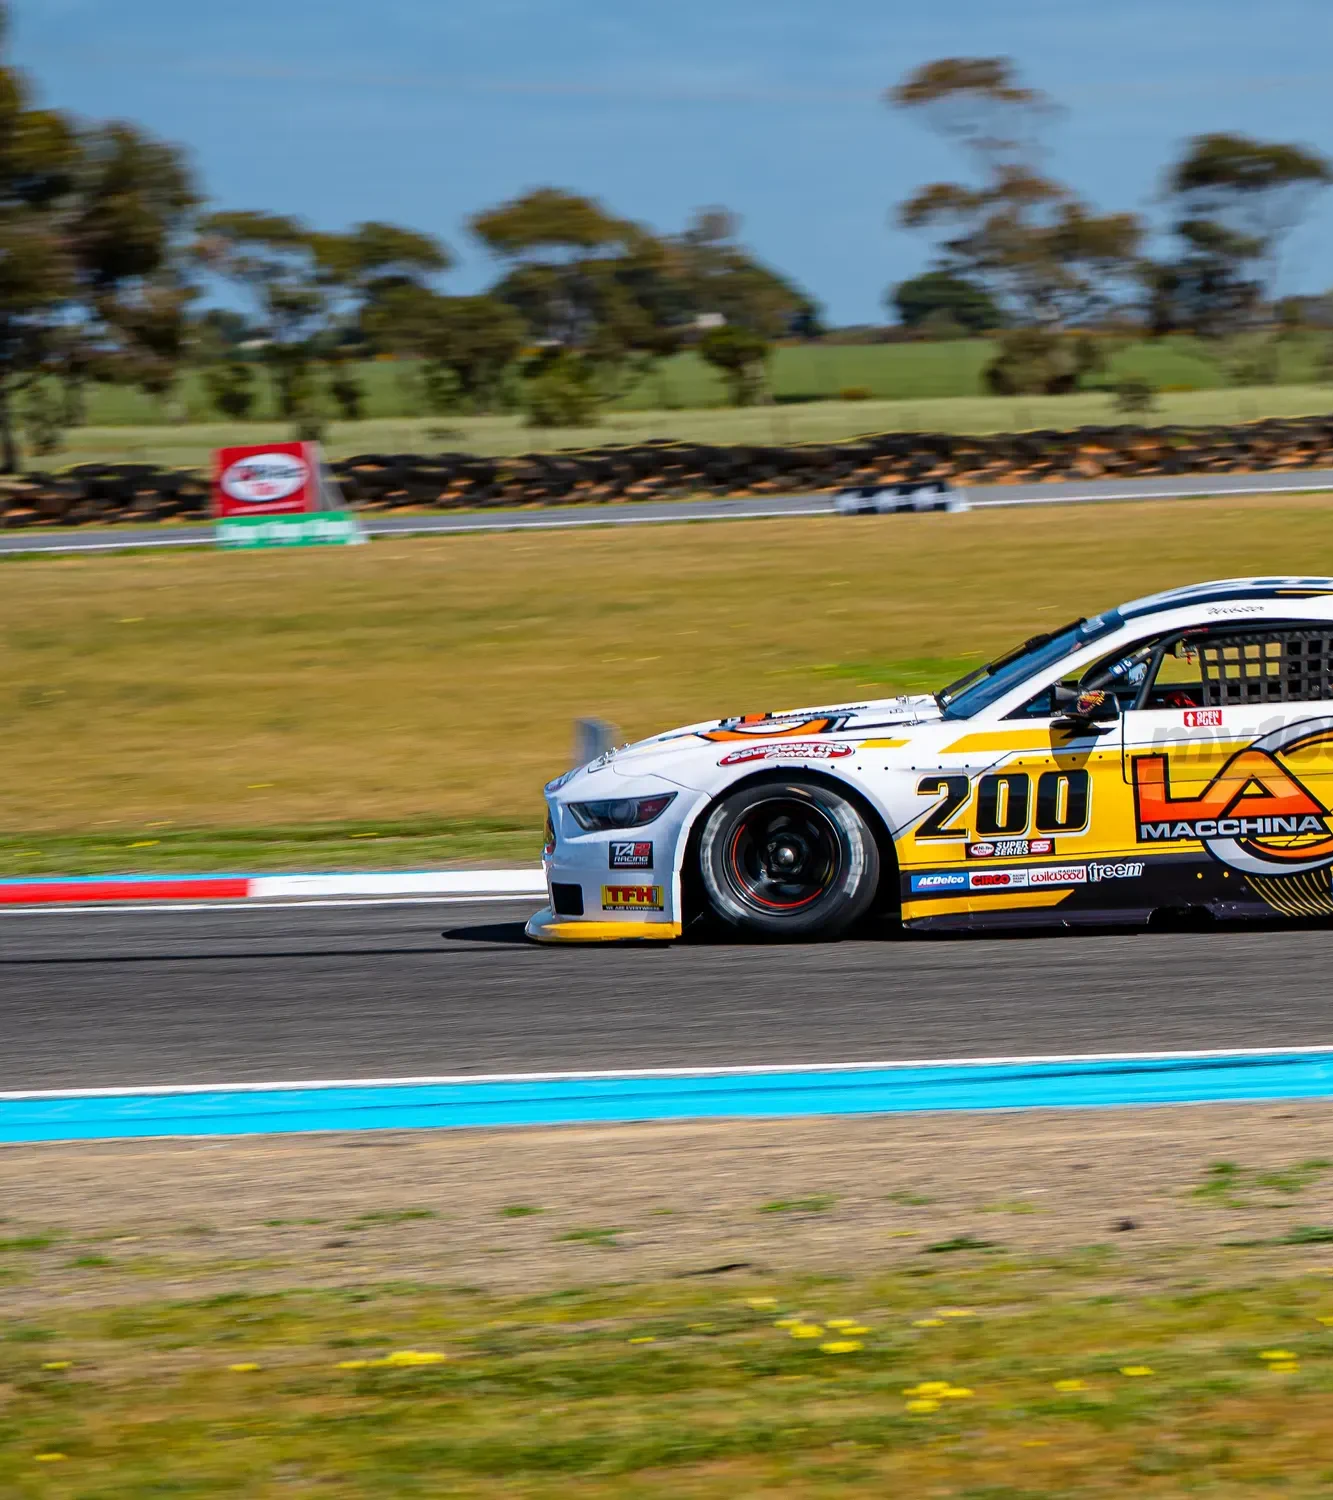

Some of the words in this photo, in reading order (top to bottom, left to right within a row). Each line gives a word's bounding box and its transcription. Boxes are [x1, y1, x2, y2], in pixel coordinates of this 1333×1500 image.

[1196, 711, 1219, 719] OPEN
[1196, 718, 1219, 726] PULL
[915, 769, 1092, 843] 200
[1141, 816, 1324, 839] MACCHINA
[611, 843, 651, 855] TA2
[996, 840, 1029, 850] SUPER
[994, 847, 1029, 856] SERIES
[918, 876, 965, 886] ACDelco
[971, 874, 1011, 886] CIRCO
[1031, 869, 1084, 882] wilwood
[607, 886, 653, 902] TFH
